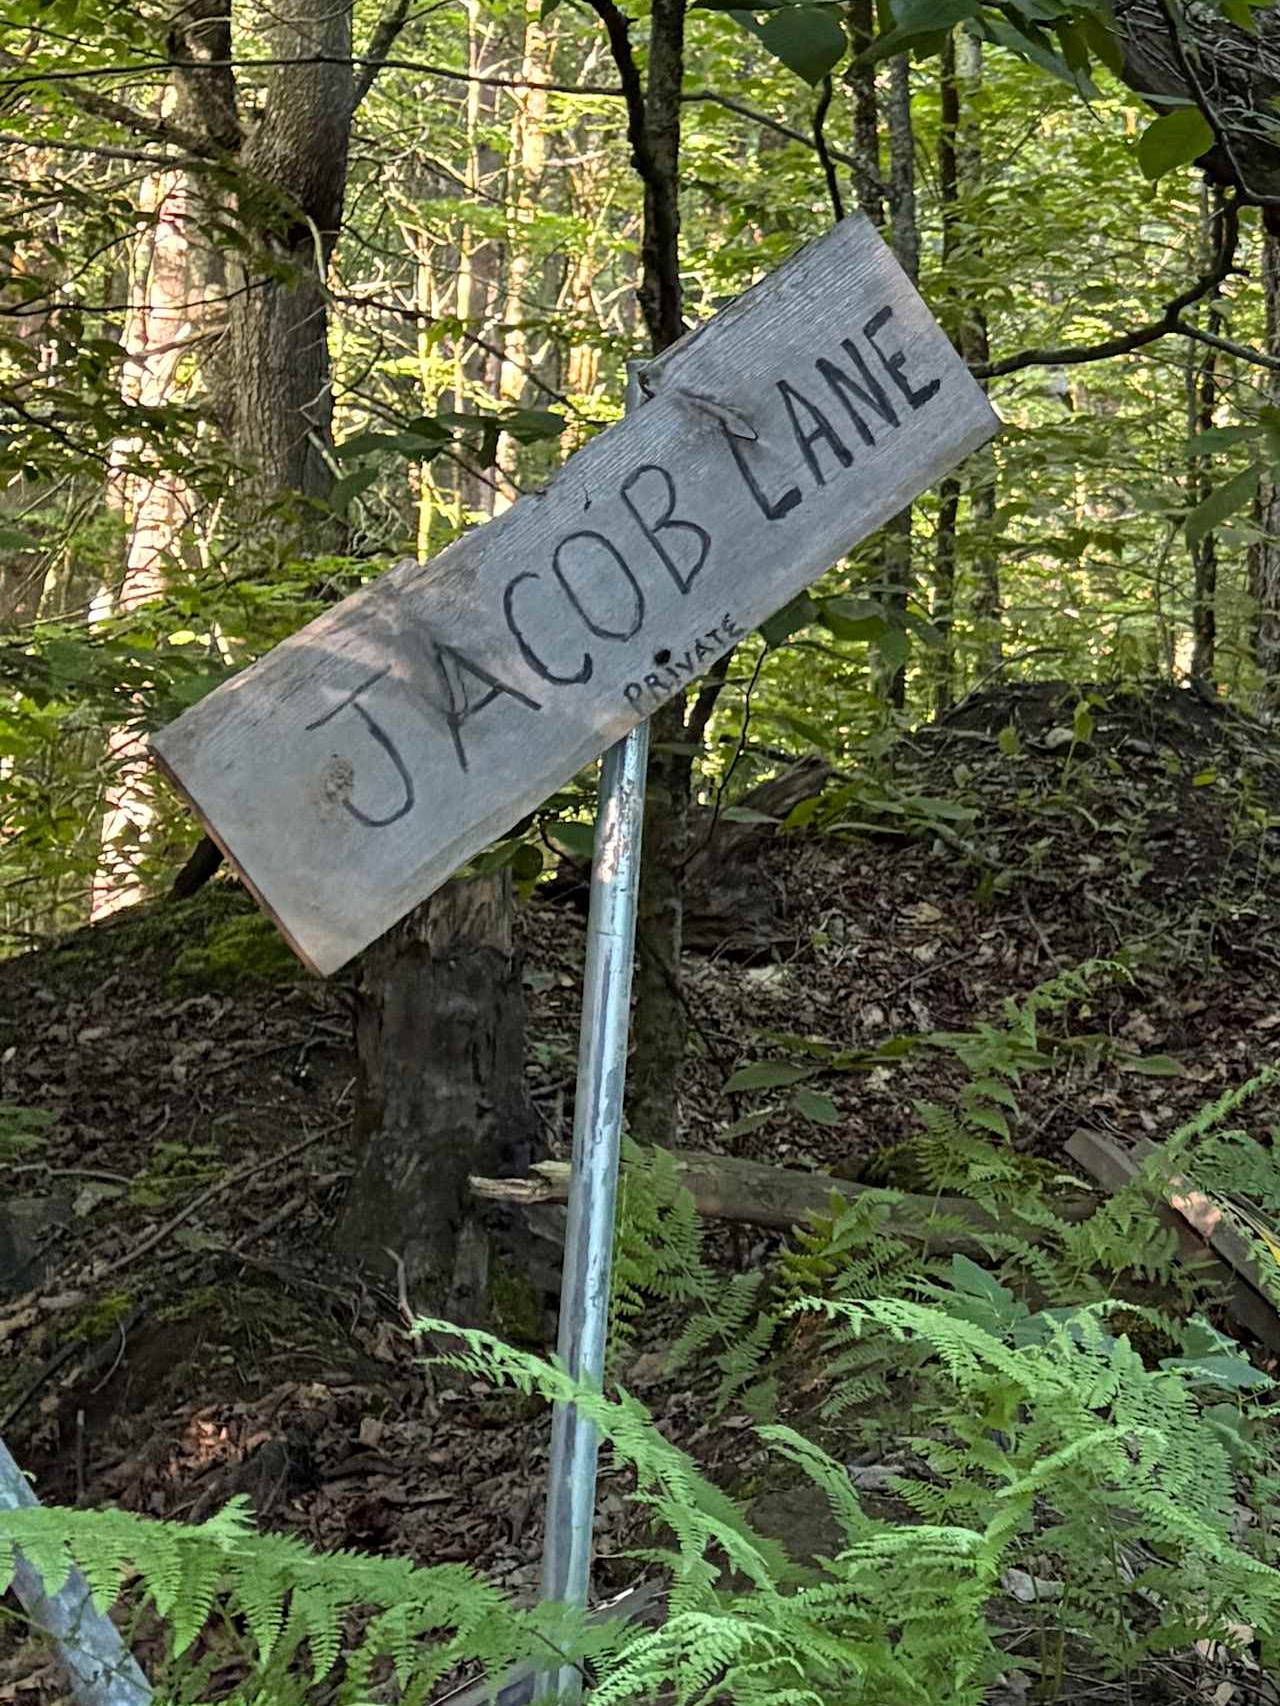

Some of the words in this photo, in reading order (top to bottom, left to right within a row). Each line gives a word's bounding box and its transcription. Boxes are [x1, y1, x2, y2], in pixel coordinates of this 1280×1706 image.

[305, 465, 712, 827] JACOB
[723, 305, 942, 520] LANE
[623, 613, 742, 717] PRIVATE
